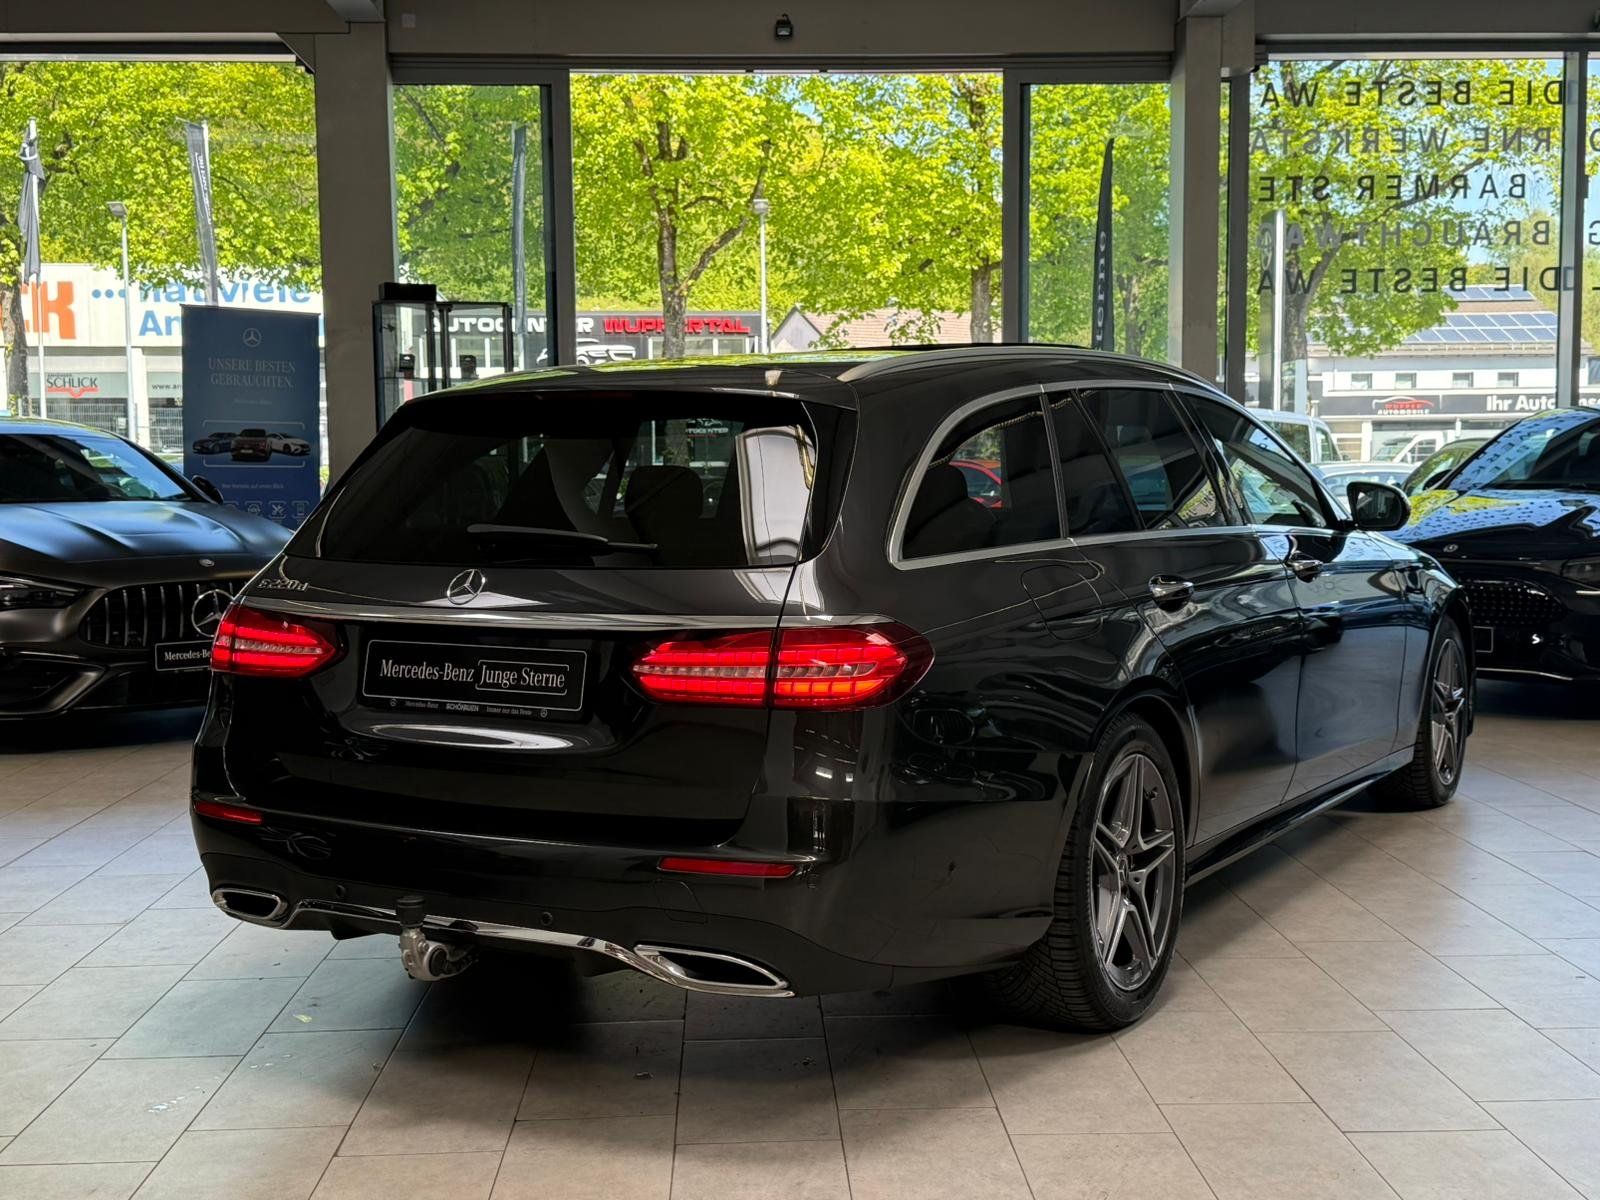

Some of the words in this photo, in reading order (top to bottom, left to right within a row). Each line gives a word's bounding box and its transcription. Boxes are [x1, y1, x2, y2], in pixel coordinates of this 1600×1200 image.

[208, 357, 251, 371] UNSERE
[256, 360, 296, 374] BESTEN
[47, 377, 98, 388] SCHLICK
[1486, 395, 1512, 411] Ihr
[164, 648, 211, 662] Mercedes-Be
[380, 659, 474, 682] Mercedes-Benz
[479, 664, 518, 689] Junge
[520, 666, 565, 688] Sterne
